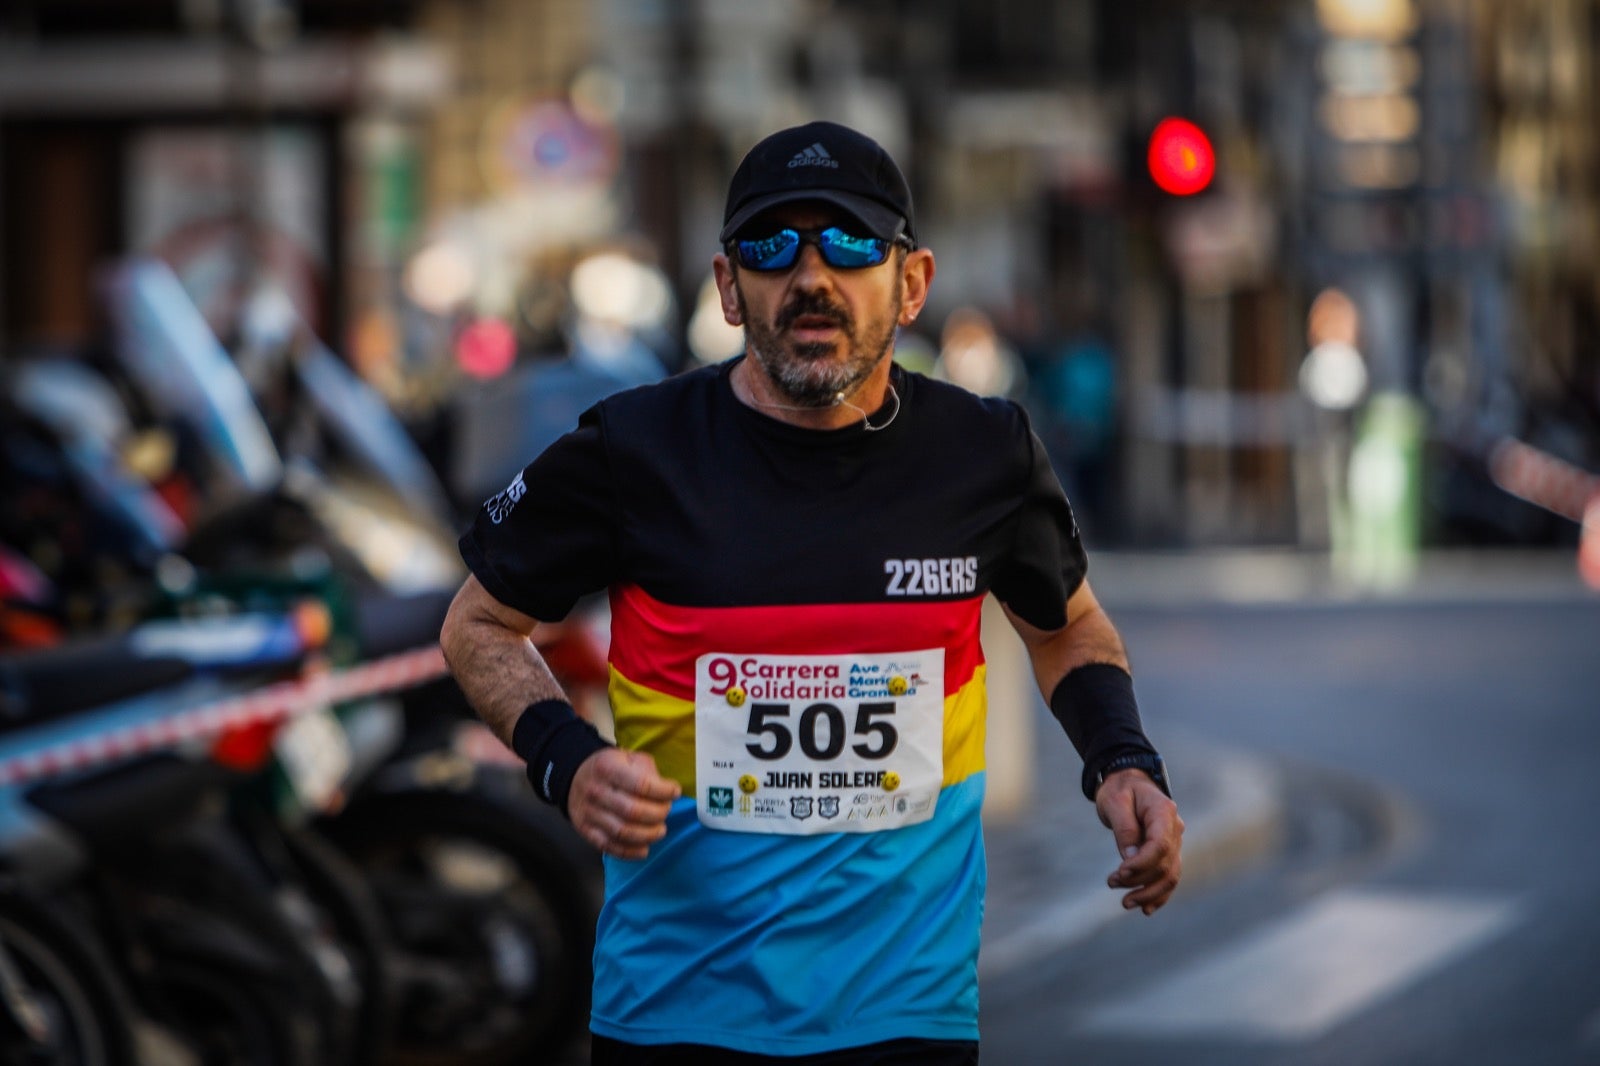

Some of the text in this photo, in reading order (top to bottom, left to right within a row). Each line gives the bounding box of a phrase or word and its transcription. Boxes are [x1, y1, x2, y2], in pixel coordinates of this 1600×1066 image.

[787, 156, 839, 168] adidas
[884, 556, 978, 595] 226ERS
[708, 657, 839, 696] 9 Carrera
[850, 663, 879, 674] Ave
[741, 679, 846, 699] Solidaria
[848, 686, 917, 698] Grana
[745, 702, 898, 761] 505
[763, 771, 813, 789] JUAN
